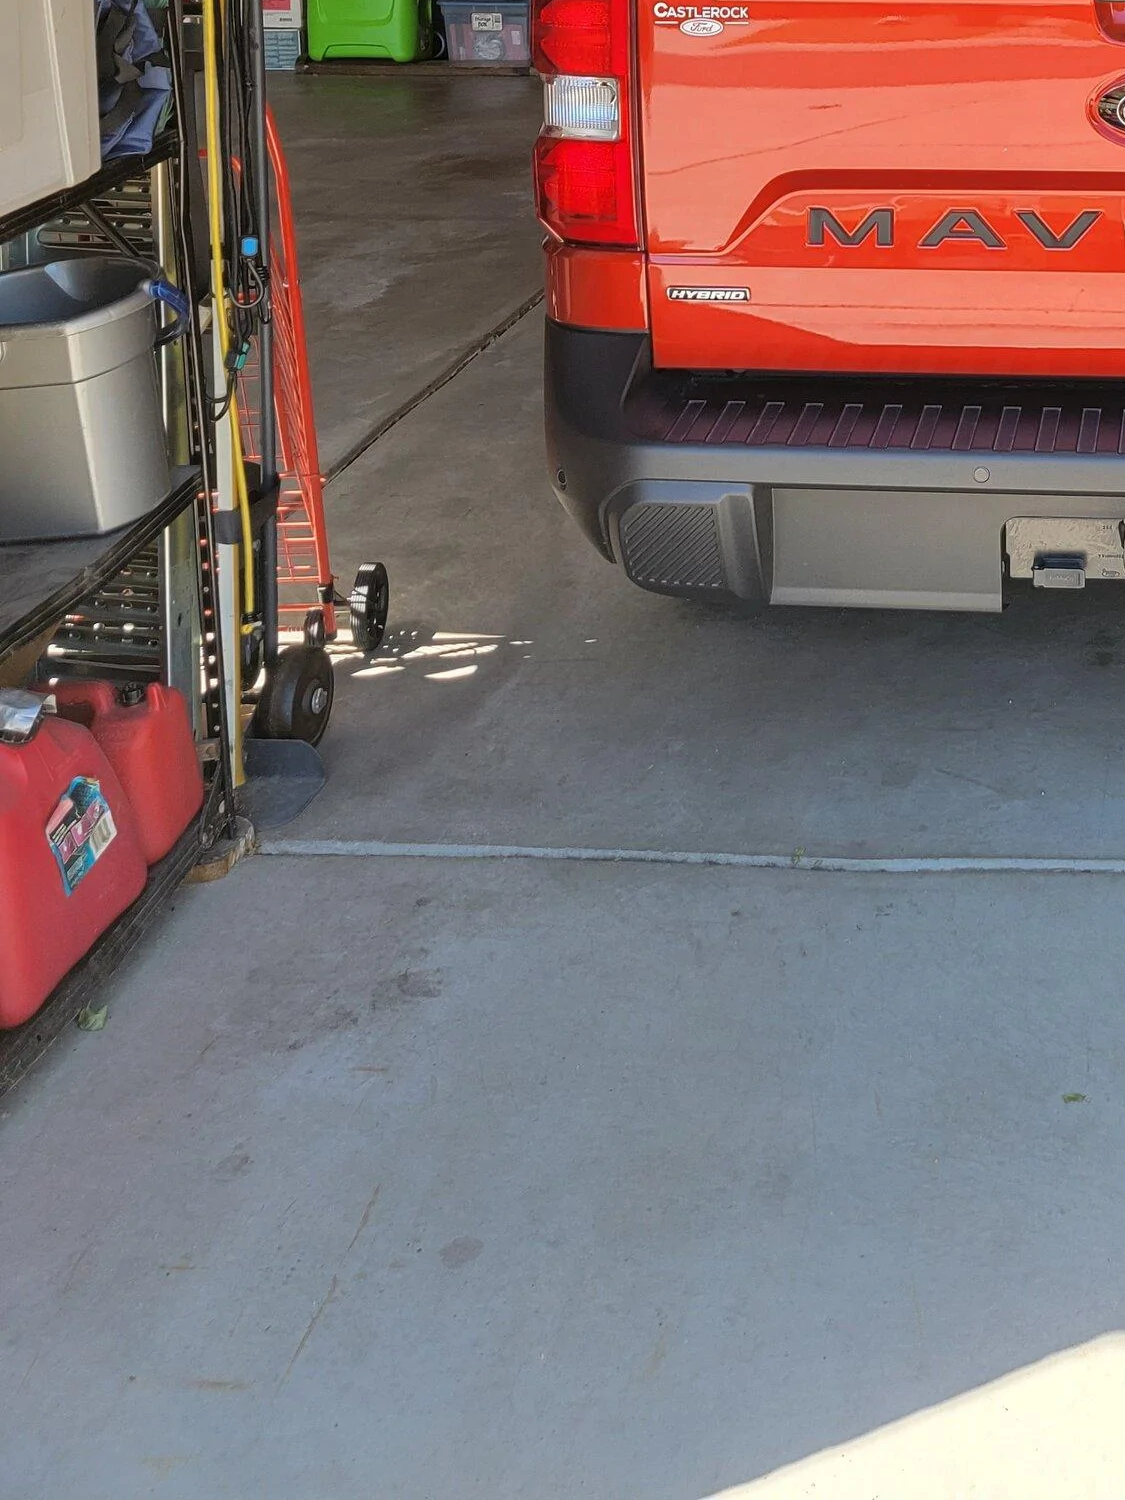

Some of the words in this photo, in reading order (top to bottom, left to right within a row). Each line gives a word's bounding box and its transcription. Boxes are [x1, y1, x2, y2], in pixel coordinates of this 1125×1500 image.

[653, 1, 749, 19] CASTLEROCK
[690, 22, 714, 32] Ford
[670, 289, 748, 302] HYBRID
